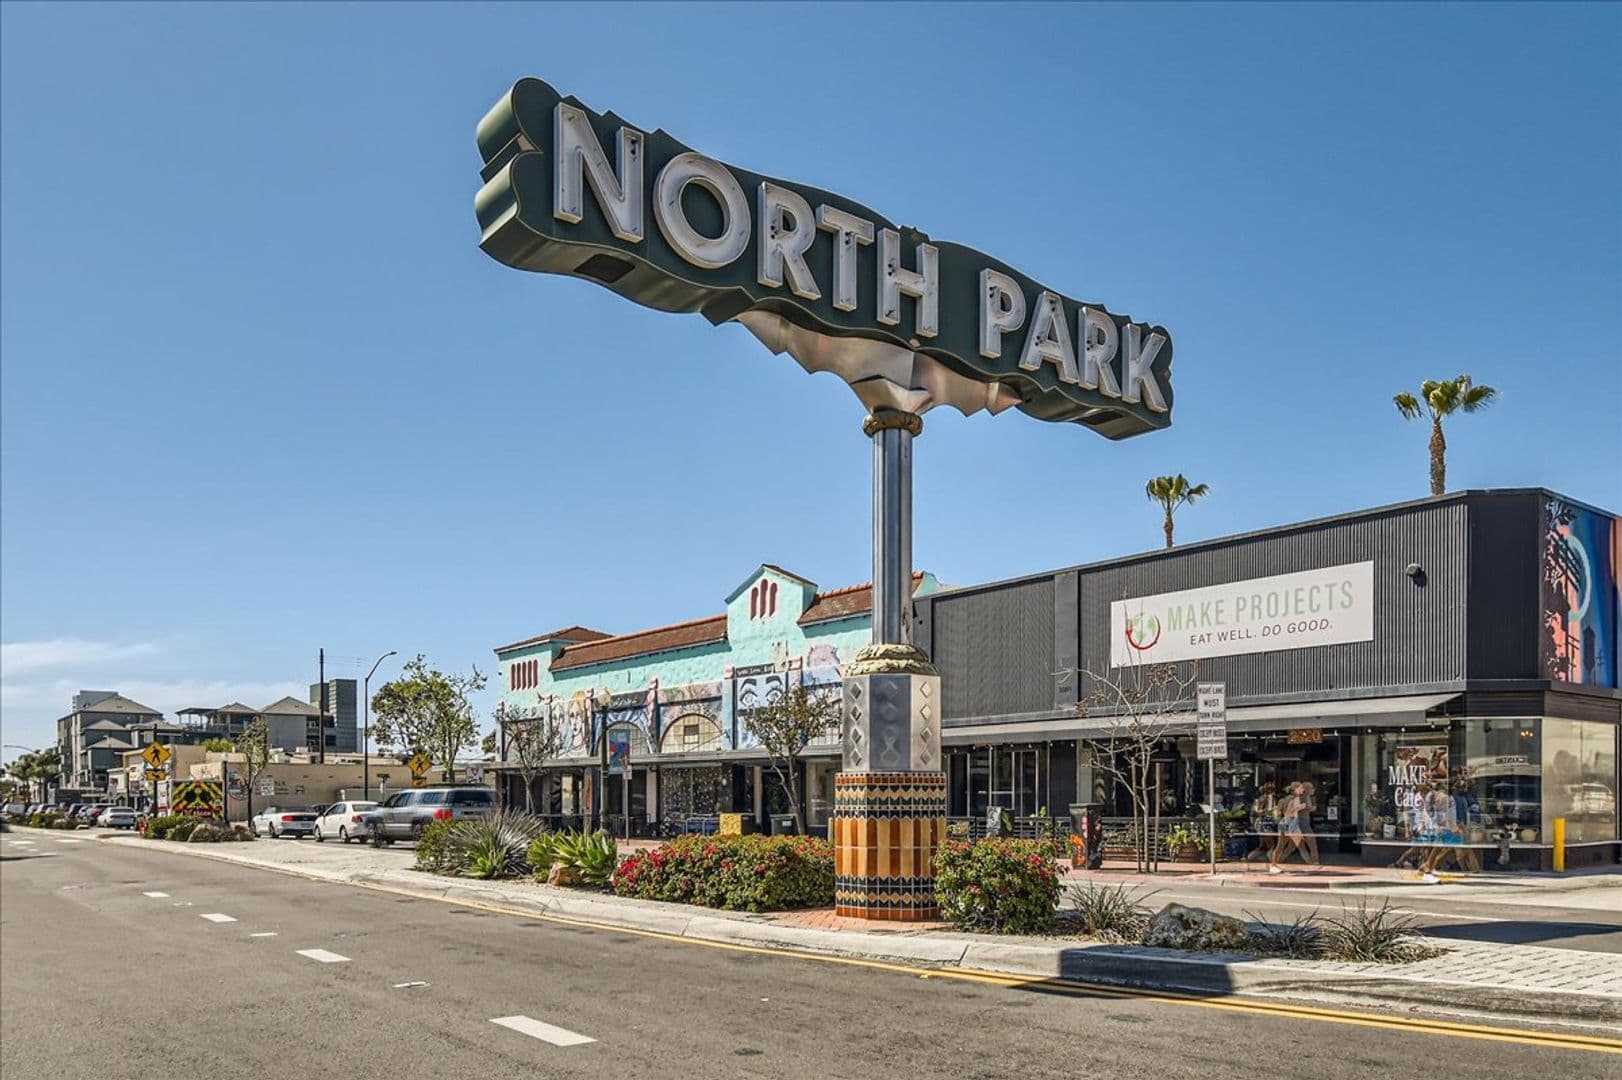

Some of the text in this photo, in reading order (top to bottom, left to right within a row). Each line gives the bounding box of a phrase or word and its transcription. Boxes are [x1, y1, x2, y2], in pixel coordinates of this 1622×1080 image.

[553, 101, 1167, 413] NORTH PARK
[1167, 580, 1354, 632] MAKE PROJECTS
[1190, 618, 1333, 646] EAT WELL. DO GOOD.
[1203, 698, 1219, 707] MUST
[1388, 765, 1426, 785] MAKE
